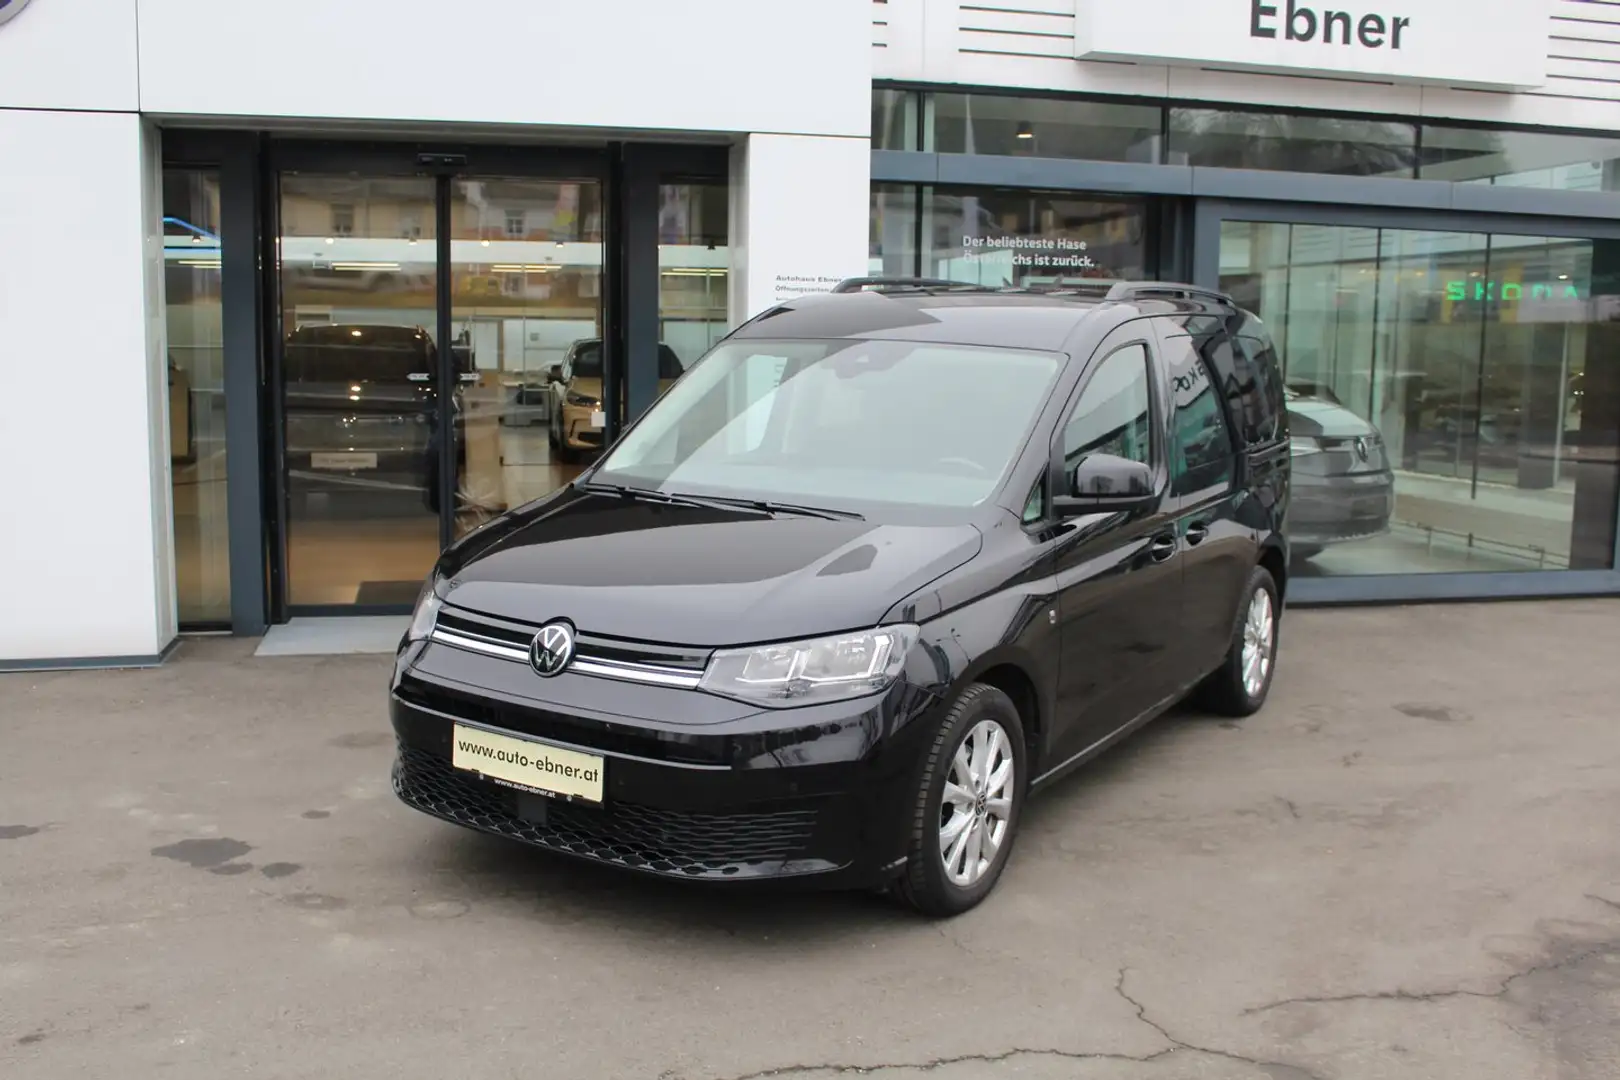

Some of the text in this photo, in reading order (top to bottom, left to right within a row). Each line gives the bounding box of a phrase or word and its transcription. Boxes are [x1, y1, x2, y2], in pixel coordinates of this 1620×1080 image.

[1250, 0, 1410, 49] Ebner
[963, 235, 1087, 250] Der beliebteste Hase
[1034, 253, 1050, 266] ist
[1051, 254, 1095, 268] zurück.
[776, 275, 816, 283] Autohaus
[457, 739, 599, 783] www.auto-ebner.at
[493, 778, 556, 799] www.auto-ebner.at
